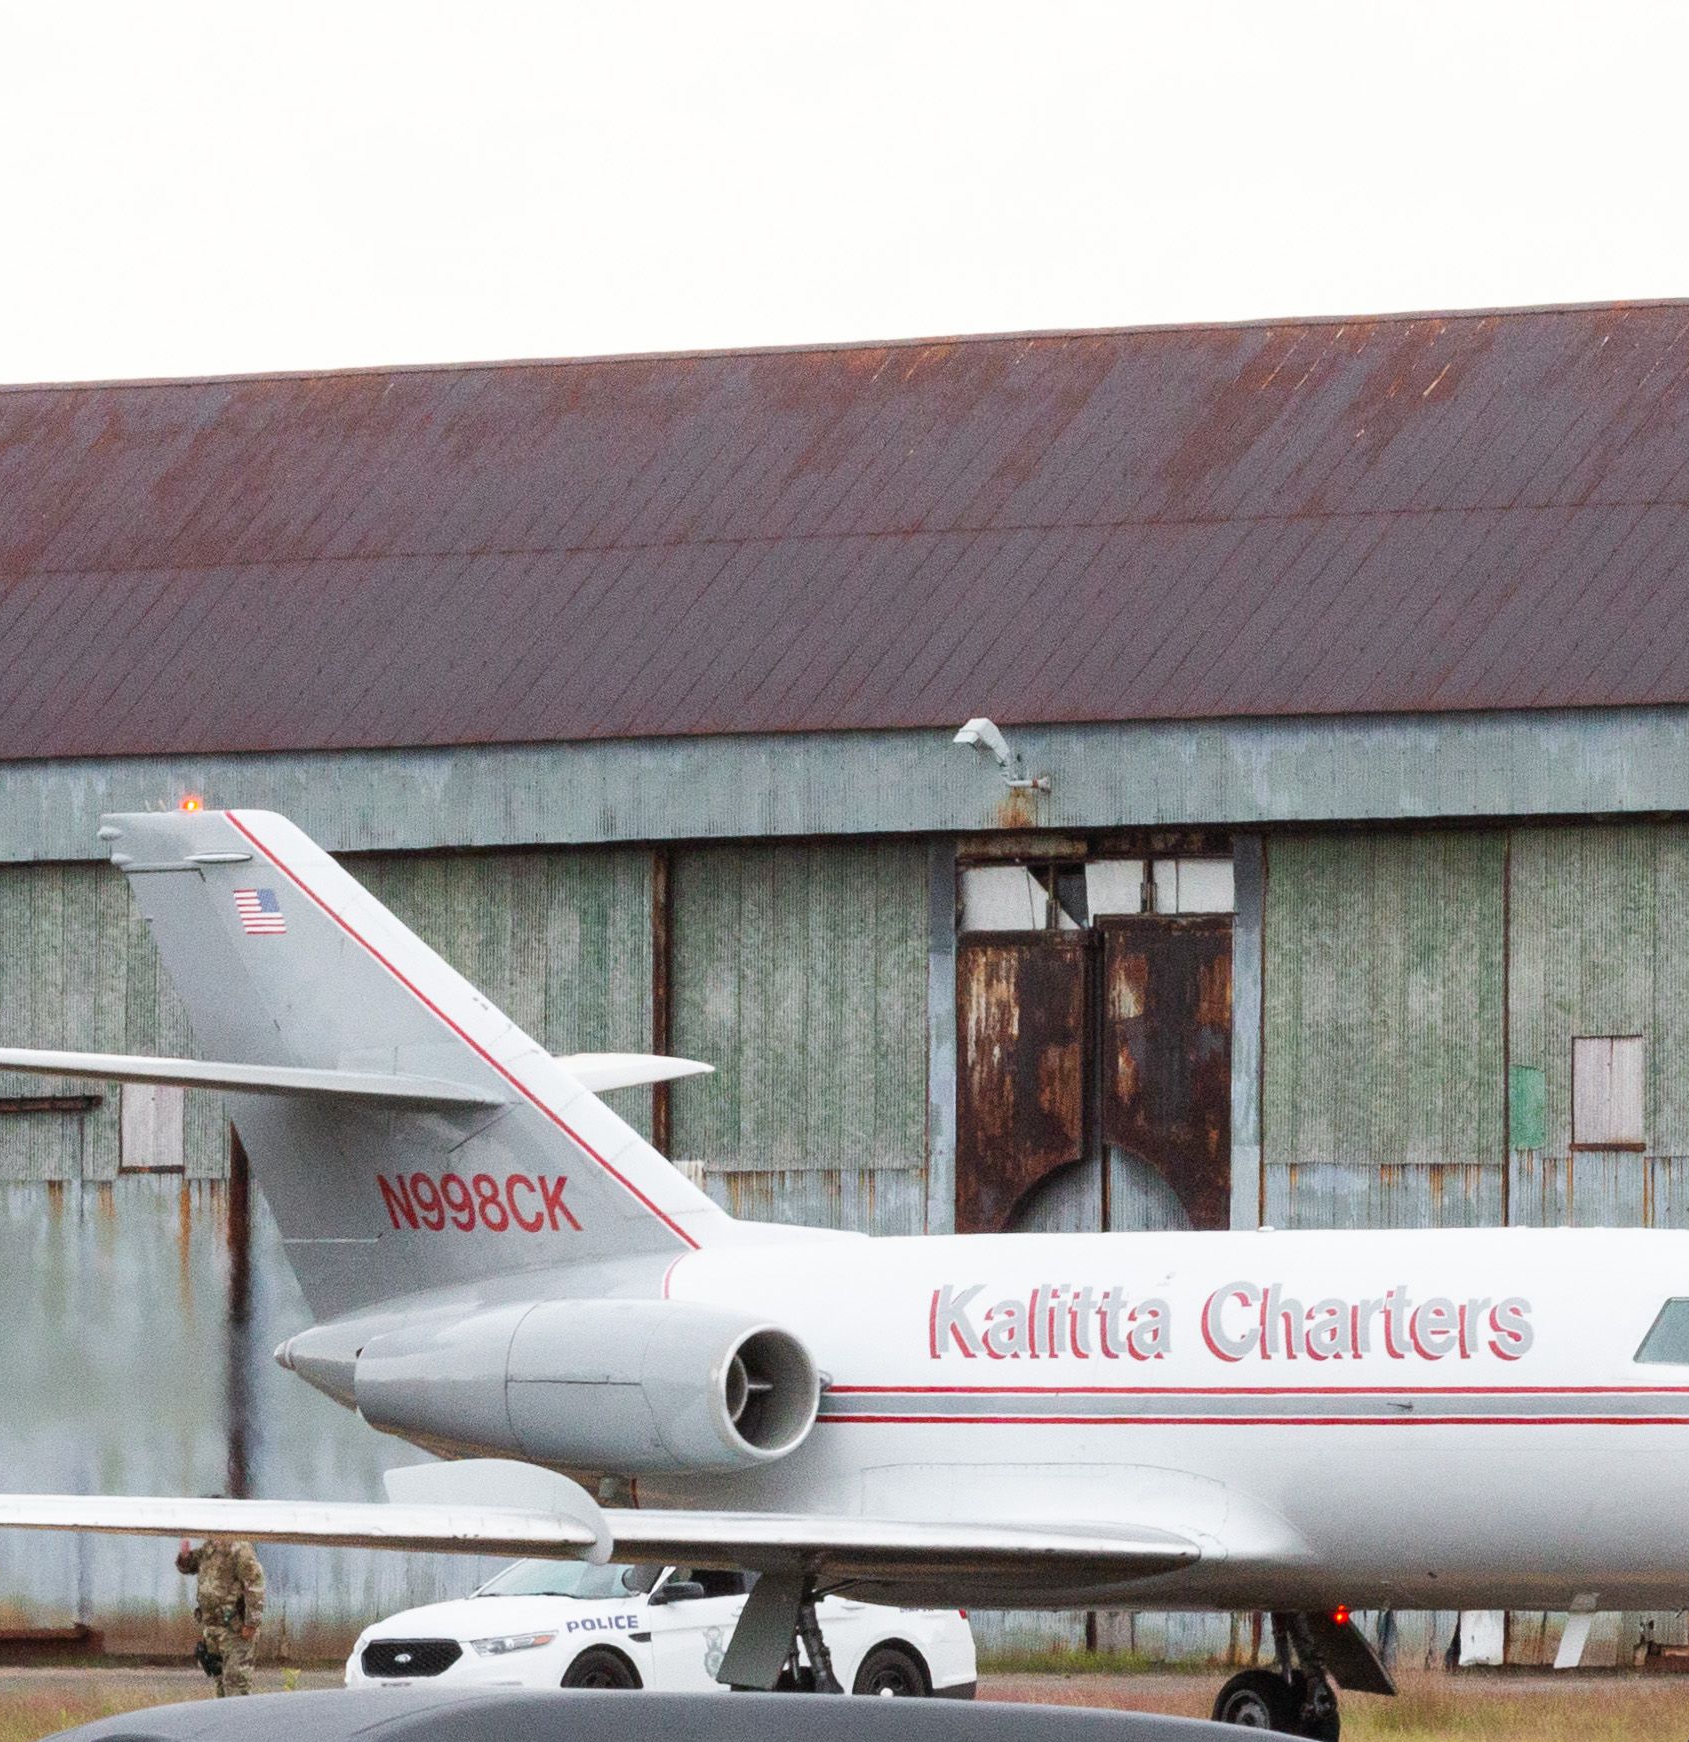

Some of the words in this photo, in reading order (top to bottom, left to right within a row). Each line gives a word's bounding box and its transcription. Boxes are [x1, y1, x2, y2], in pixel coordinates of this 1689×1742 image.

[376, 1172, 584, 1233] N998CK
[929, 1284, 1172, 1359] Kalitta
[1201, 1281, 1535, 1362] Charters
[565, 1614, 639, 1633] POLICE
